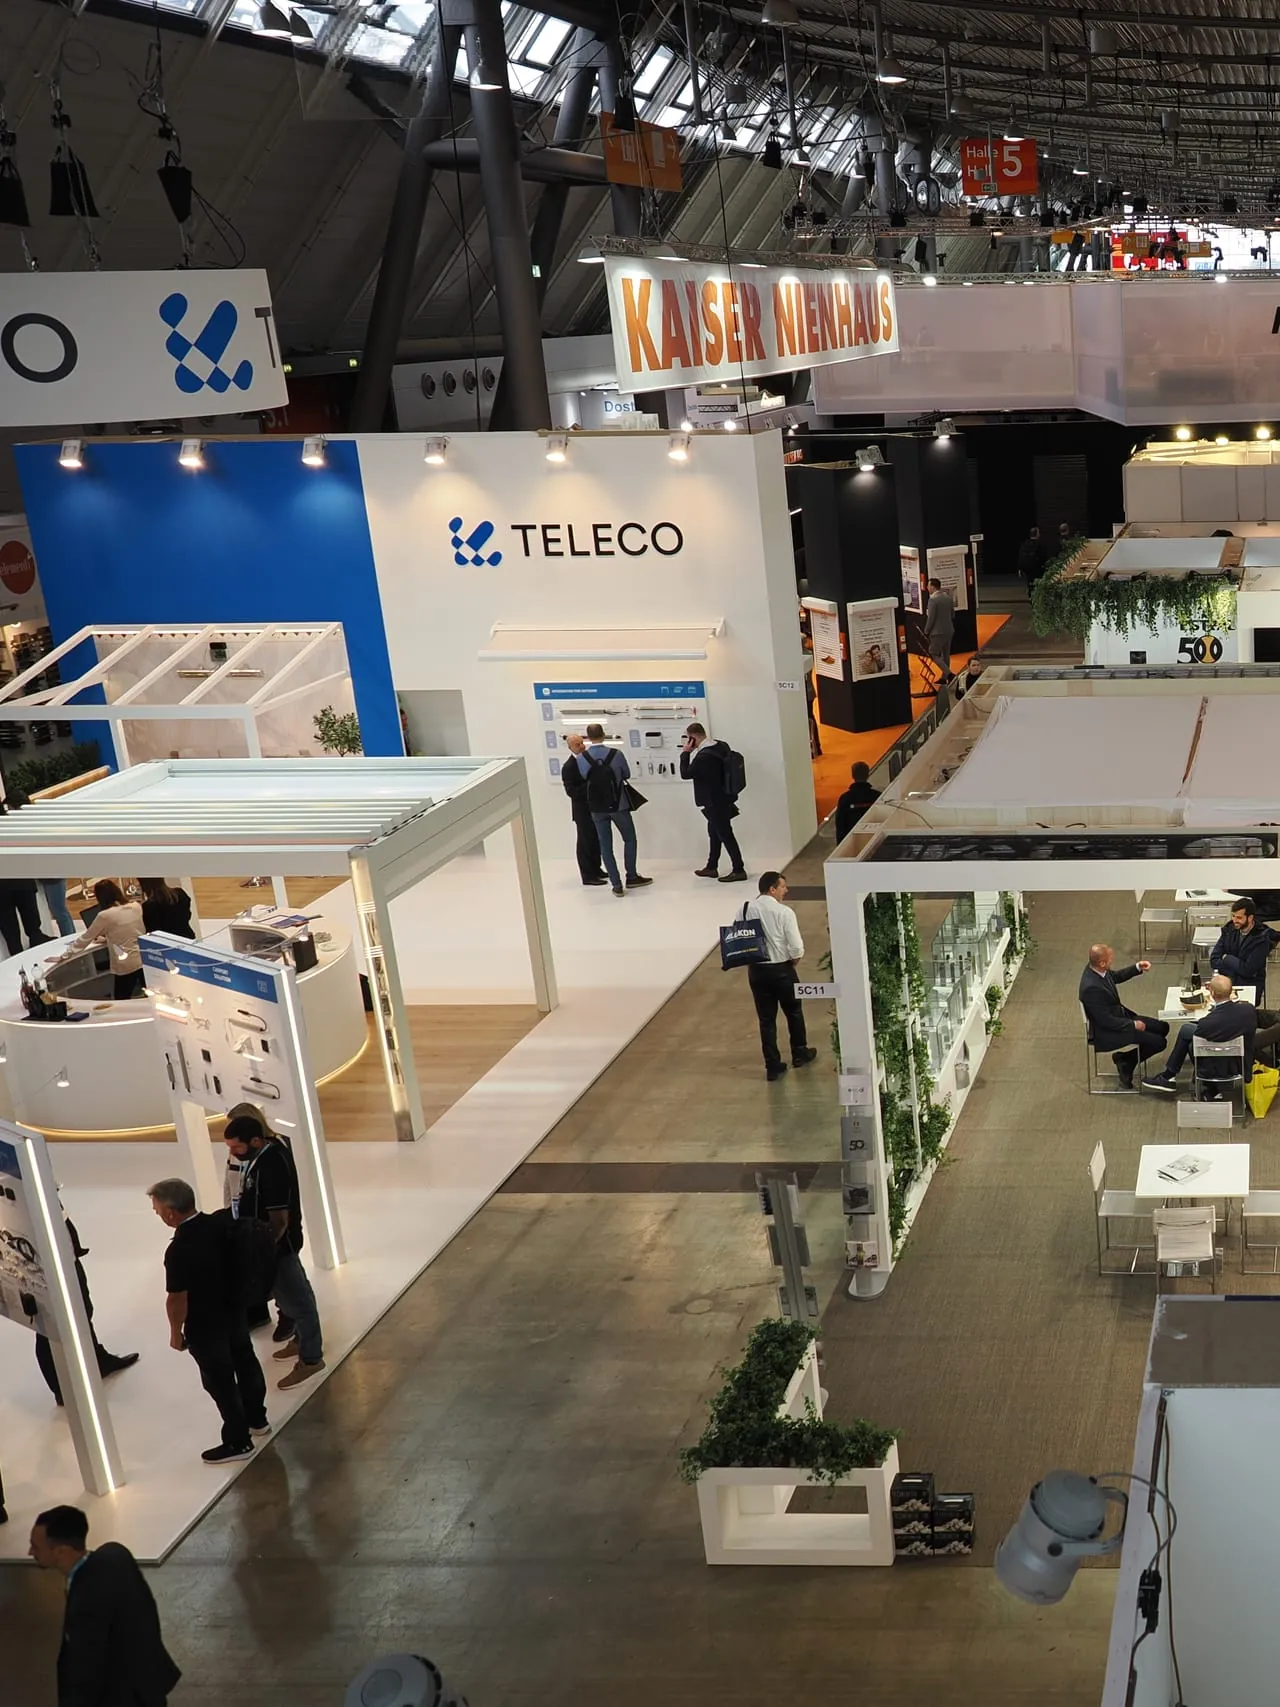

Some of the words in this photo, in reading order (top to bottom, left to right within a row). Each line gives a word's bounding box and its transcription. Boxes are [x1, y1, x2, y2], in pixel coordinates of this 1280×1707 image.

[966, 144, 999, 158] Halle
[1002, 145, 1022, 177] 5
[967, 164, 992, 177] Hll
[621, 277, 766, 373] KAISER
[772, 282, 893, 358] NIENHAUS
[510, 522, 684, 557] TELECO
[797, 986, 825, 995] 5C11
